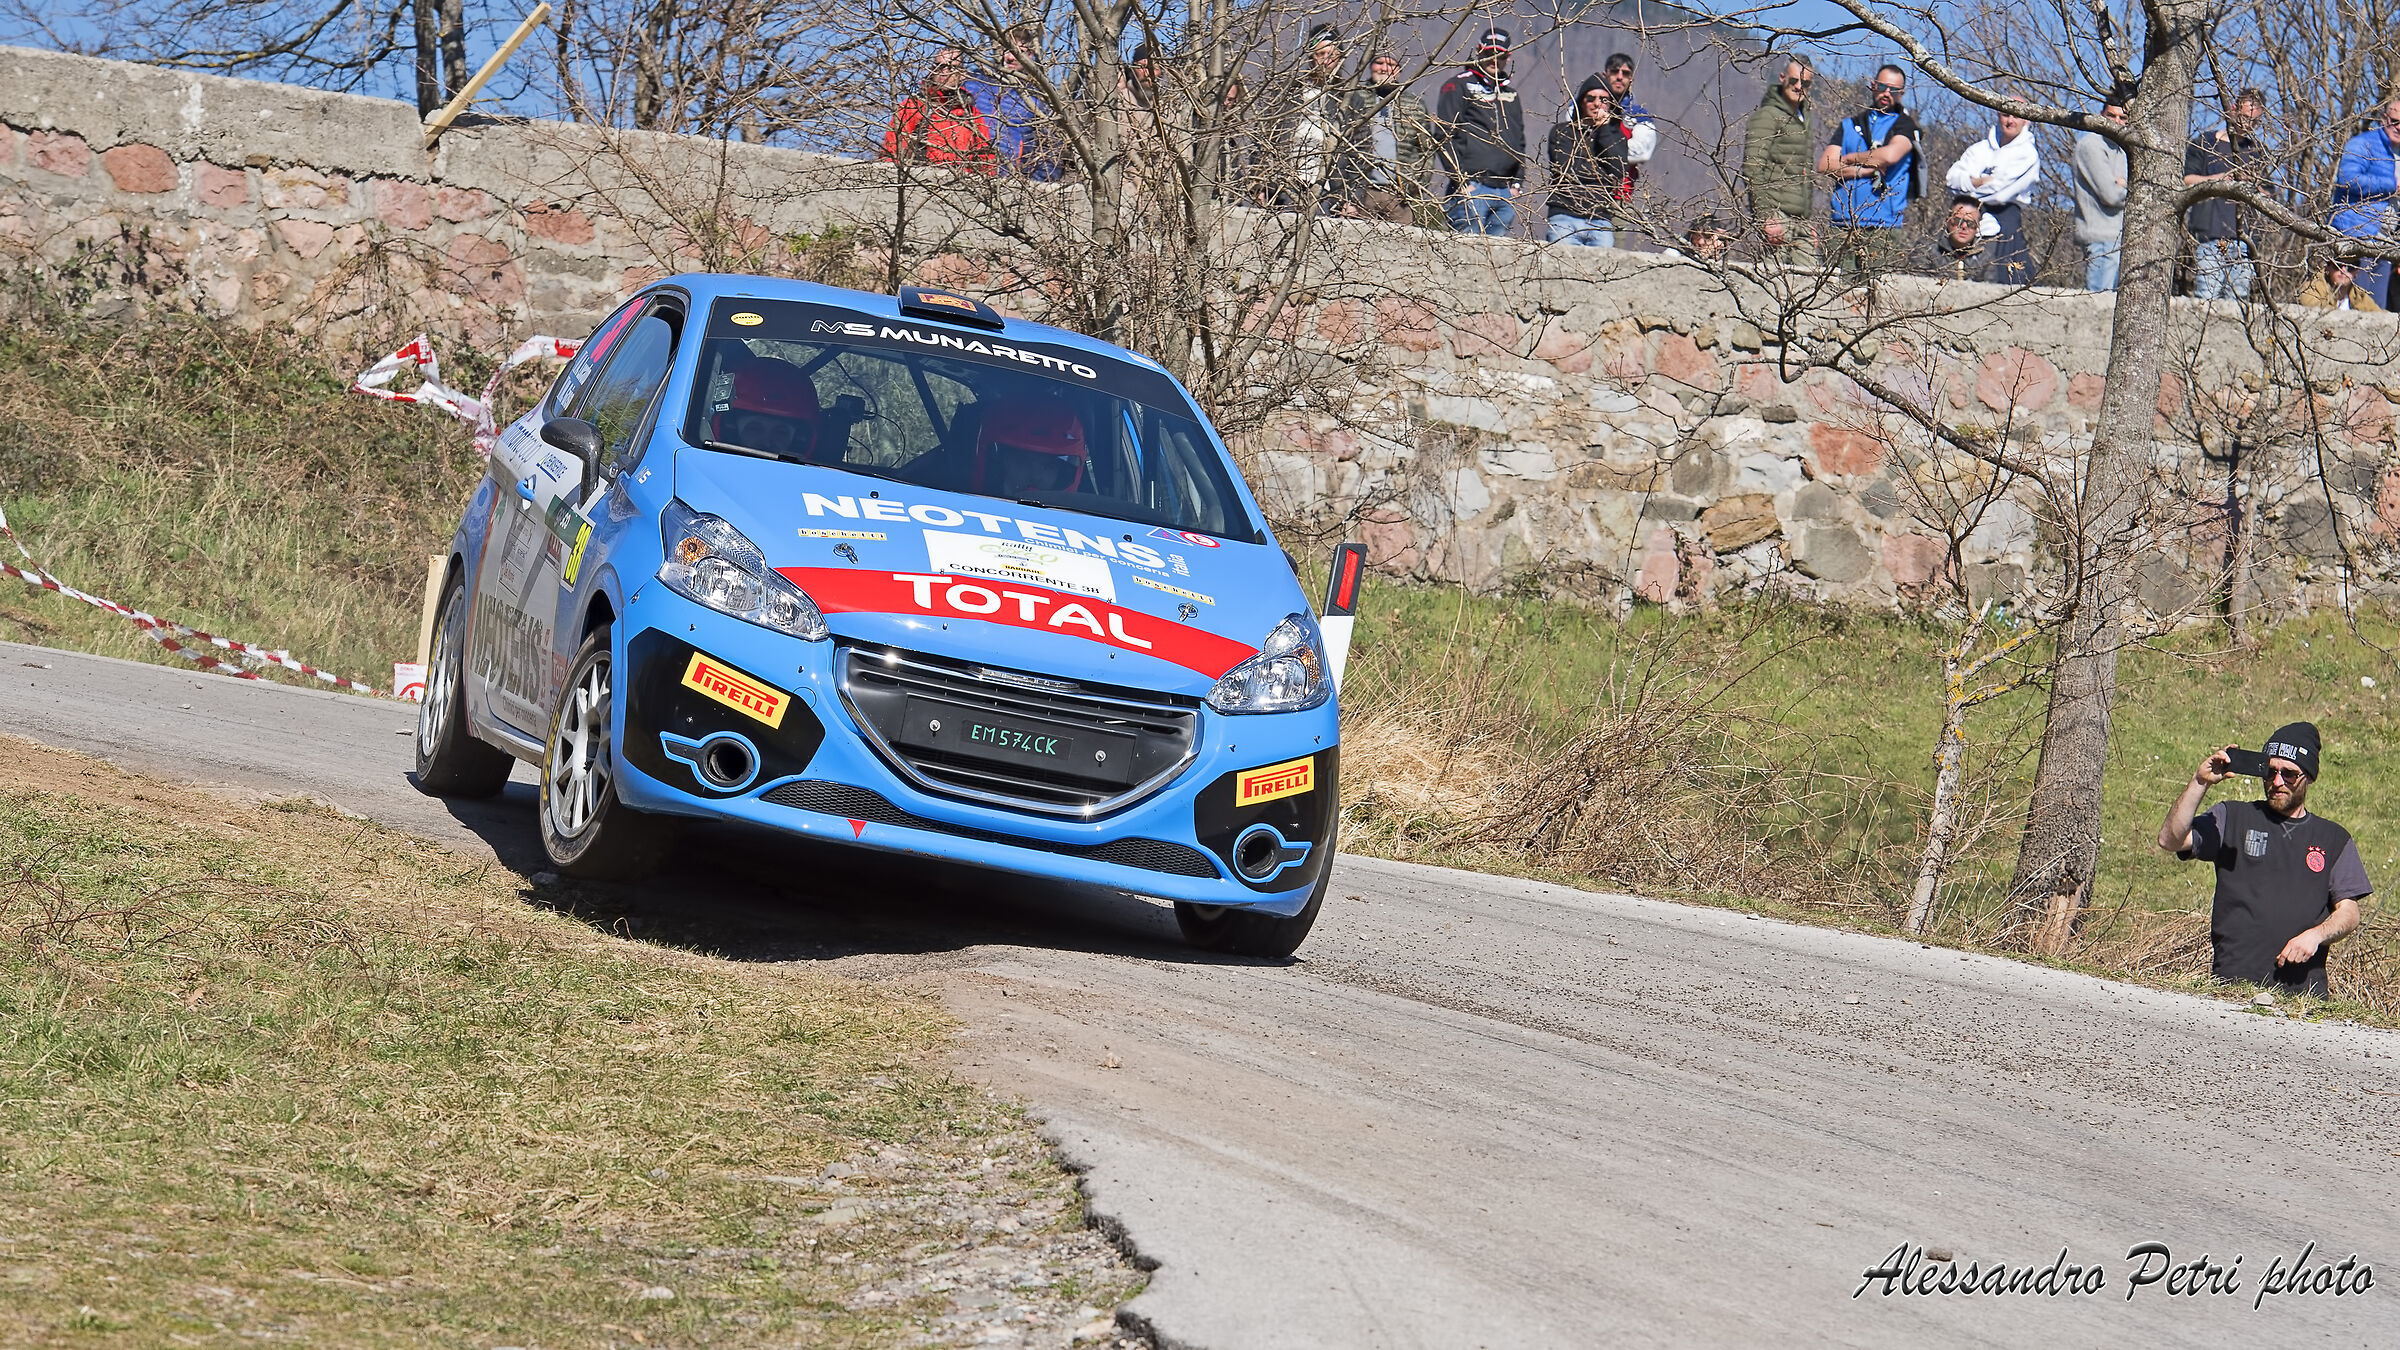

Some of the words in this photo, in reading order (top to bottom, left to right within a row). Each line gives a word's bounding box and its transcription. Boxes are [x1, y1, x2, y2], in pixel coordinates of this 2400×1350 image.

[880, 326, 1097, 379] MUNARETTO
[802, 492, 1166, 566] NEOTENS
[949, 563, 1078, 591] CONCORRENTE
[1081, 585, 1100, 595] 38
[1024, 538, 1078, 554] Chimici
[1081, 550, 1107, 561] per
[1109, 557, 1170, 578] conceria
[893, 574, 1152, 650] TOTAL
[692, 661, 779, 718] PIRELLI
[1243, 764, 1309, 799] PIRELLI
